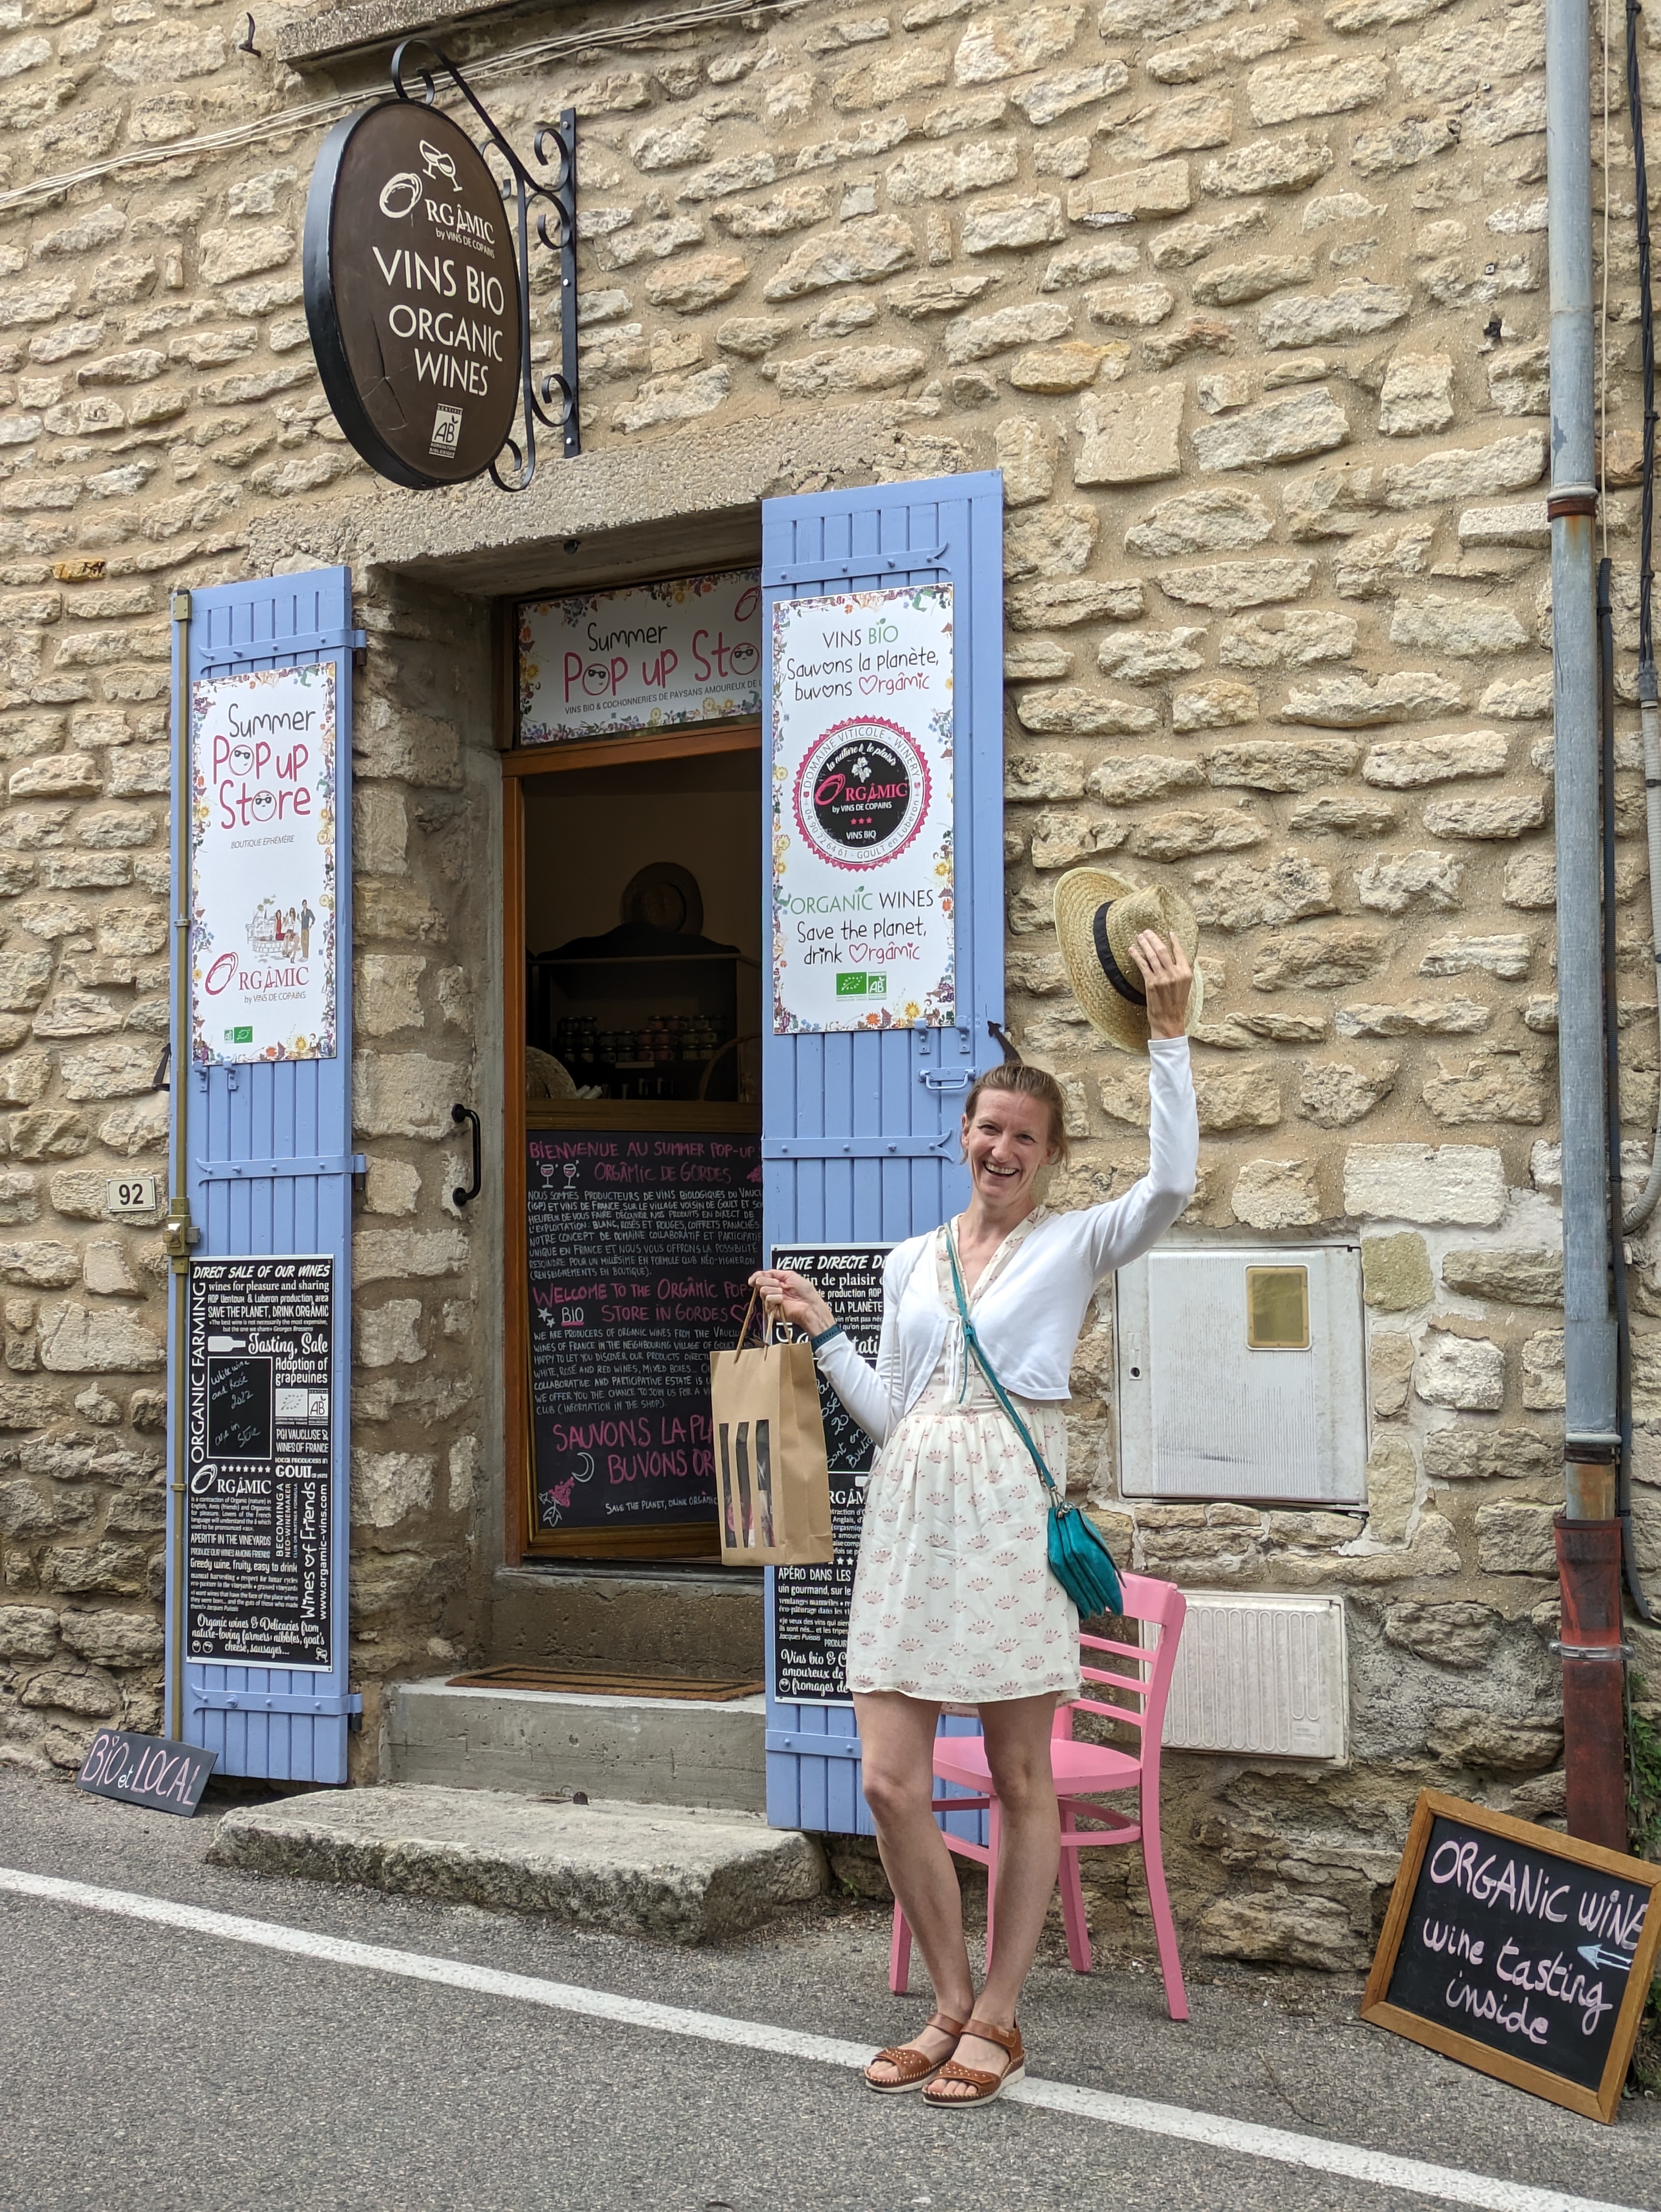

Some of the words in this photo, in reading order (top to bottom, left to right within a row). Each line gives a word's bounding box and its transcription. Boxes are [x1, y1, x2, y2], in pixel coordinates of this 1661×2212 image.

[435, 227, 445, 241] by
[446, 230, 462, 243] VINS
[463, 236, 472, 248] DE
[472, 240, 495, 258] COPAINS
[372, 246, 456, 297] VINS
[467, 265, 504, 316] BIO
[389, 304, 503, 362] ORGANIC
[414, 347, 488, 396] WINES
[434, 422, 454, 443] AB
[587, 622, 668, 652] Summer
[822, 630, 861, 648] VINS
[868, 622, 898, 644] BIO
[859, 653, 870, 670] la
[877, 647, 939, 672] planète,
[565, 706, 581, 714] VINS
[583, 704, 594, 712] BIO
[603, 694, 657, 709] COCHONNERIES
[670, 688, 702, 699] PAYSANS
[705, 681, 746, 694] AMOUREUX
[748, 680, 757, 689] DE
[228, 703, 316, 739] Summer
[804, 738, 836, 788] DOMAINE
[838, 727, 885, 742] VITICOLE
[895, 738, 920, 776] WINERY
[827, 760, 836, 772] la
[219, 779, 311, 830] Store
[865, 802, 892, 810] COPAINS
[846, 831, 863, 840] VINS
[857, 845, 885, 859] GOULT
[897, 801, 919, 837] Luberon
[231, 839, 263, 849] BOUTIQUE
[790, 888, 873, 915] ORGANIC
[879, 889, 933, 909] WINES
[797, 921, 834, 943] Save
[841, 919, 867, 940] the
[874, 917, 926, 940] planet,
[804, 943, 842, 964] drink
[869, 980, 885, 993] AB
[244, 996, 252, 1004] by
[626, 1141, 648, 1157] AU
[654, 1141, 705, 1157] SUMMER
[710, 1142, 754, 1158] POP-UP
[661, 1165, 677, 1182] DE
[680, 1161, 731, 1184] GORDES
[119, 1183, 144, 1205] 92
[528, 1191, 547, 1201] NOUS
[550, 1191, 579, 1200] SOMMES
[585, 1191, 640, 1201] PRODUCTEURS
[530, 1234, 556, 1247] NOTRE
[559, 1232, 595, 1242] CONCEPT
[193, 1266, 227, 1279] DIRECT
[228, 1266, 255, 1279] SALE
[257, 1265, 273, 1278] OF
[275, 1265, 295, 1278] OUR
[298, 1265, 331, 1277] WINES
[776, 1256, 815, 1270] VENTE
[817, 1255, 869, 1270] DIRECTE
[209, 1281, 231, 1292] wines
[233, 1280, 244, 1291] for
[246, 1280, 279, 1294] pleasure
[281, 1280, 297, 1290] and
[299, 1279, 329, 1293] sharing
[821, 1273, 836, 1286] de
[839, 1272, 876, 1289] plaisir
[533, 1283, 607, 1308] WELCOME
[609, 1283, 626, 1298] TO
[630, 1283, 651, 1297] THE
[828, 1288, 865, 1300] production
[208, 1306, 225, 1318] SAVE
[226, 1305, 240, 1318] THE
[241, 1305, 271, 1318] PLANET,
[273, 1305, 294, 1317] DRINK
[601, 1305, 650, 1322] STORE
[675, 1303, 728, 1322] GORDES
[847, 1298, 883, 1313] PLANÈTE
[192, 1282, 205, 1366] FARMING
[565, 1329, 603, 1338] PRODUCERS
[248, 1332, 298, 1360] Tasting,
[301, 1332, 328, 1354] Sale
[276, 1357, 315, 1373] Adoption
[318, 1357, 328, 1371] of
[191, 1373, 205, 1464] ORGANIC
[276, 1428, 287, 1440] PGI
[288, 1428, 321, 1440] VAUCLUSE
[553, 1416, 651, 1452] SAUVONS
[661, 1416, 687, 1445] LA
[276, 1442, 295, 1452] WINES
[296, 1442, 304, 1453] OF
[305, 1442, 329, 1453] FRANCE
[608, 1449, 688, 1484] BUVONS
[300, 1482, 316, 1540] Friends
[626, 1502, 639, 1511] THE
[641, 1500, 667, 1511] PLANET,
[191, 1533, 217, 1544] APERITIF
[218, 1534, 224, 1544] IN
[225, 1534, 238, 1545] THE
[239, 1534, 271, 1546] VINEYARDS
[778, 1565, 806, 1581] APÉRO
[809, 1569, 832, 1582] DANS
[837, 1569, 851, 1582] LES
[300, 1571, 316, 1619] Wines
[791, 1585, 830, 1596] gourmand,
[197, 1613, 227, 1630] Organic
[260, 1616, 299, 1631] Delicacies
[781, 1649, 806, 1664] Vins
[809, 1651, 823, 1665] bio
[782, 1667, 830, 1680] amoureux
[792, 1678, 834, 1697] fromages
[81, 1734, 129, 1786] BIO
[131, 1746, 200, 1805] LOCAL
[1423, 1917, 1484, 1965] wine
[1496, 1936, 1613, 2035] tasting
[1446, 1970, 1548, 2044] inside
